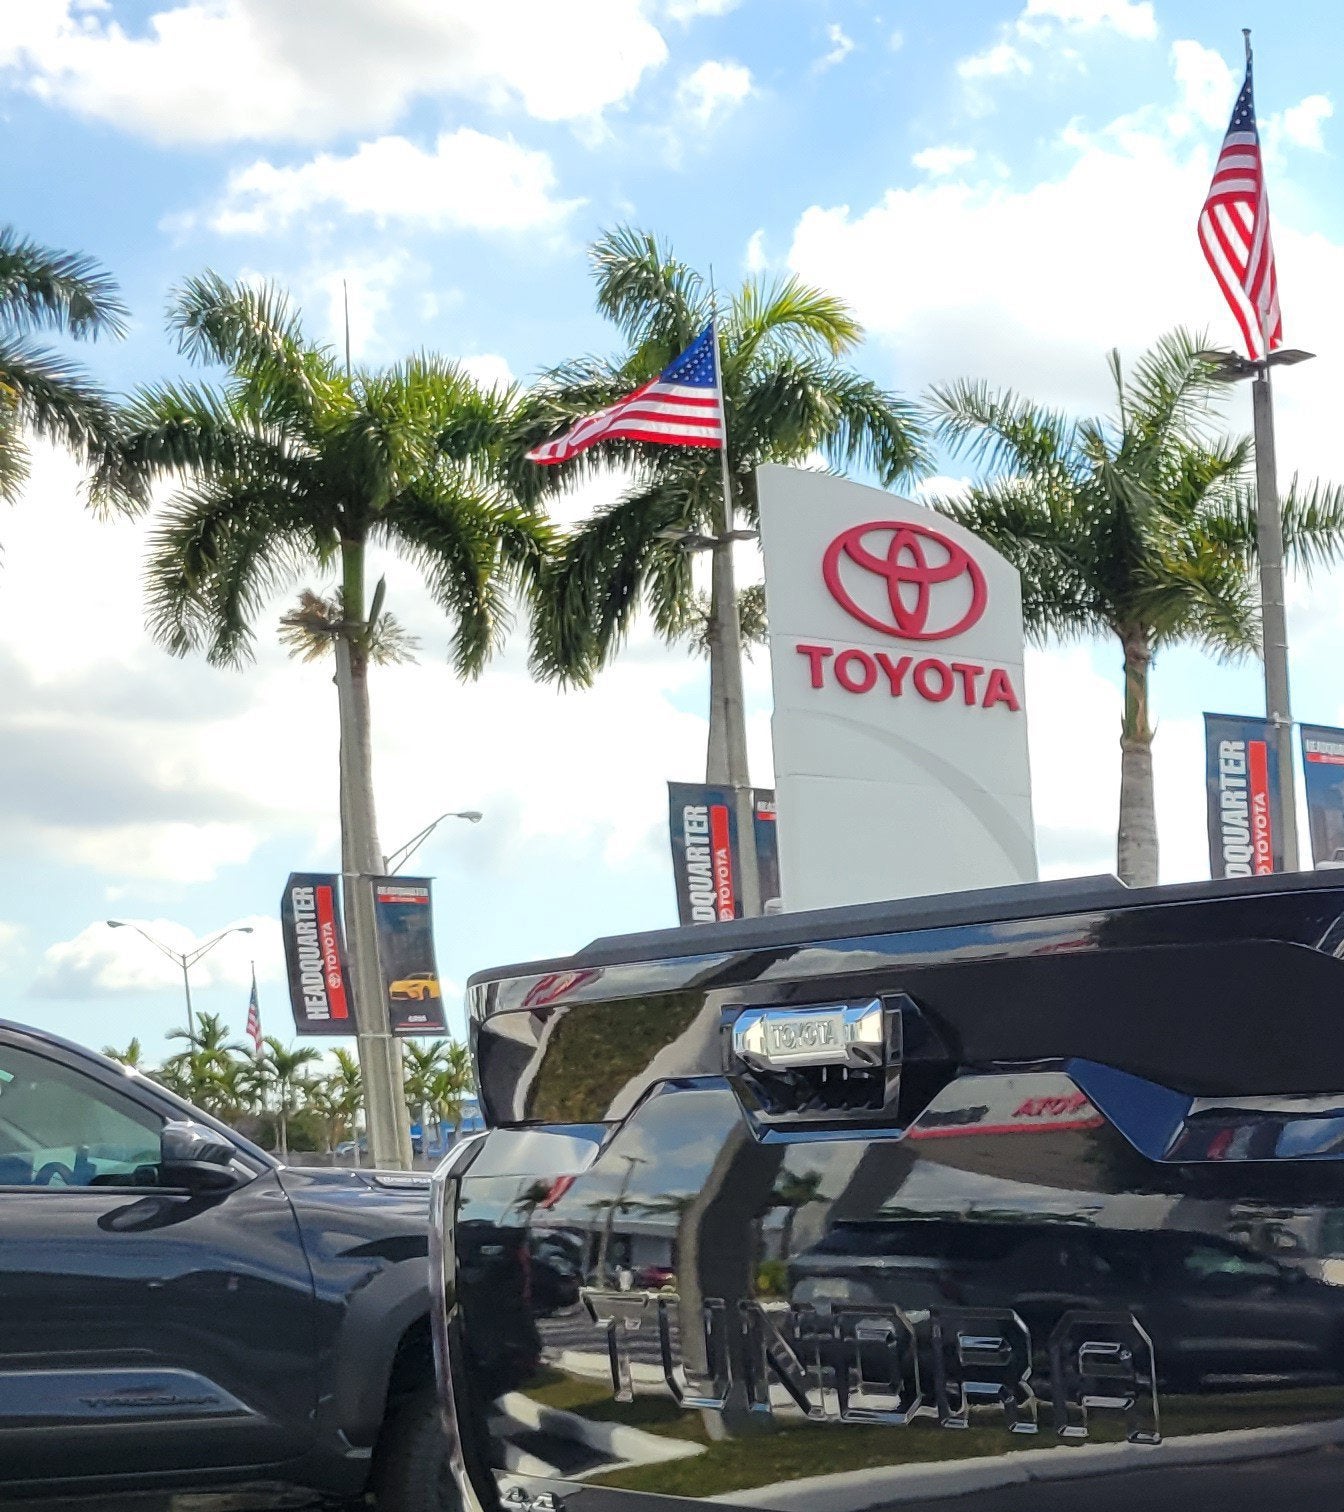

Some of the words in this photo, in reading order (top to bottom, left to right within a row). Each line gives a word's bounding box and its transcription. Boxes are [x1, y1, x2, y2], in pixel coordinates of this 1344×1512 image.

[796, 645, 1021, 712] TOYOTA
[1253, 792, 1269, 864] TOYOTA
[683, 804, 718, 923] DQUARTER
[715, 847, 731, 906] TOYOTA
[292, 886, 331, 1020] HEADQUARTER
[320, 921, 338, 972] TOYOTA
[771, 1020, 835, 1050] TOYOTA
[580, 1286, 1162, 1446] TUNDRA
